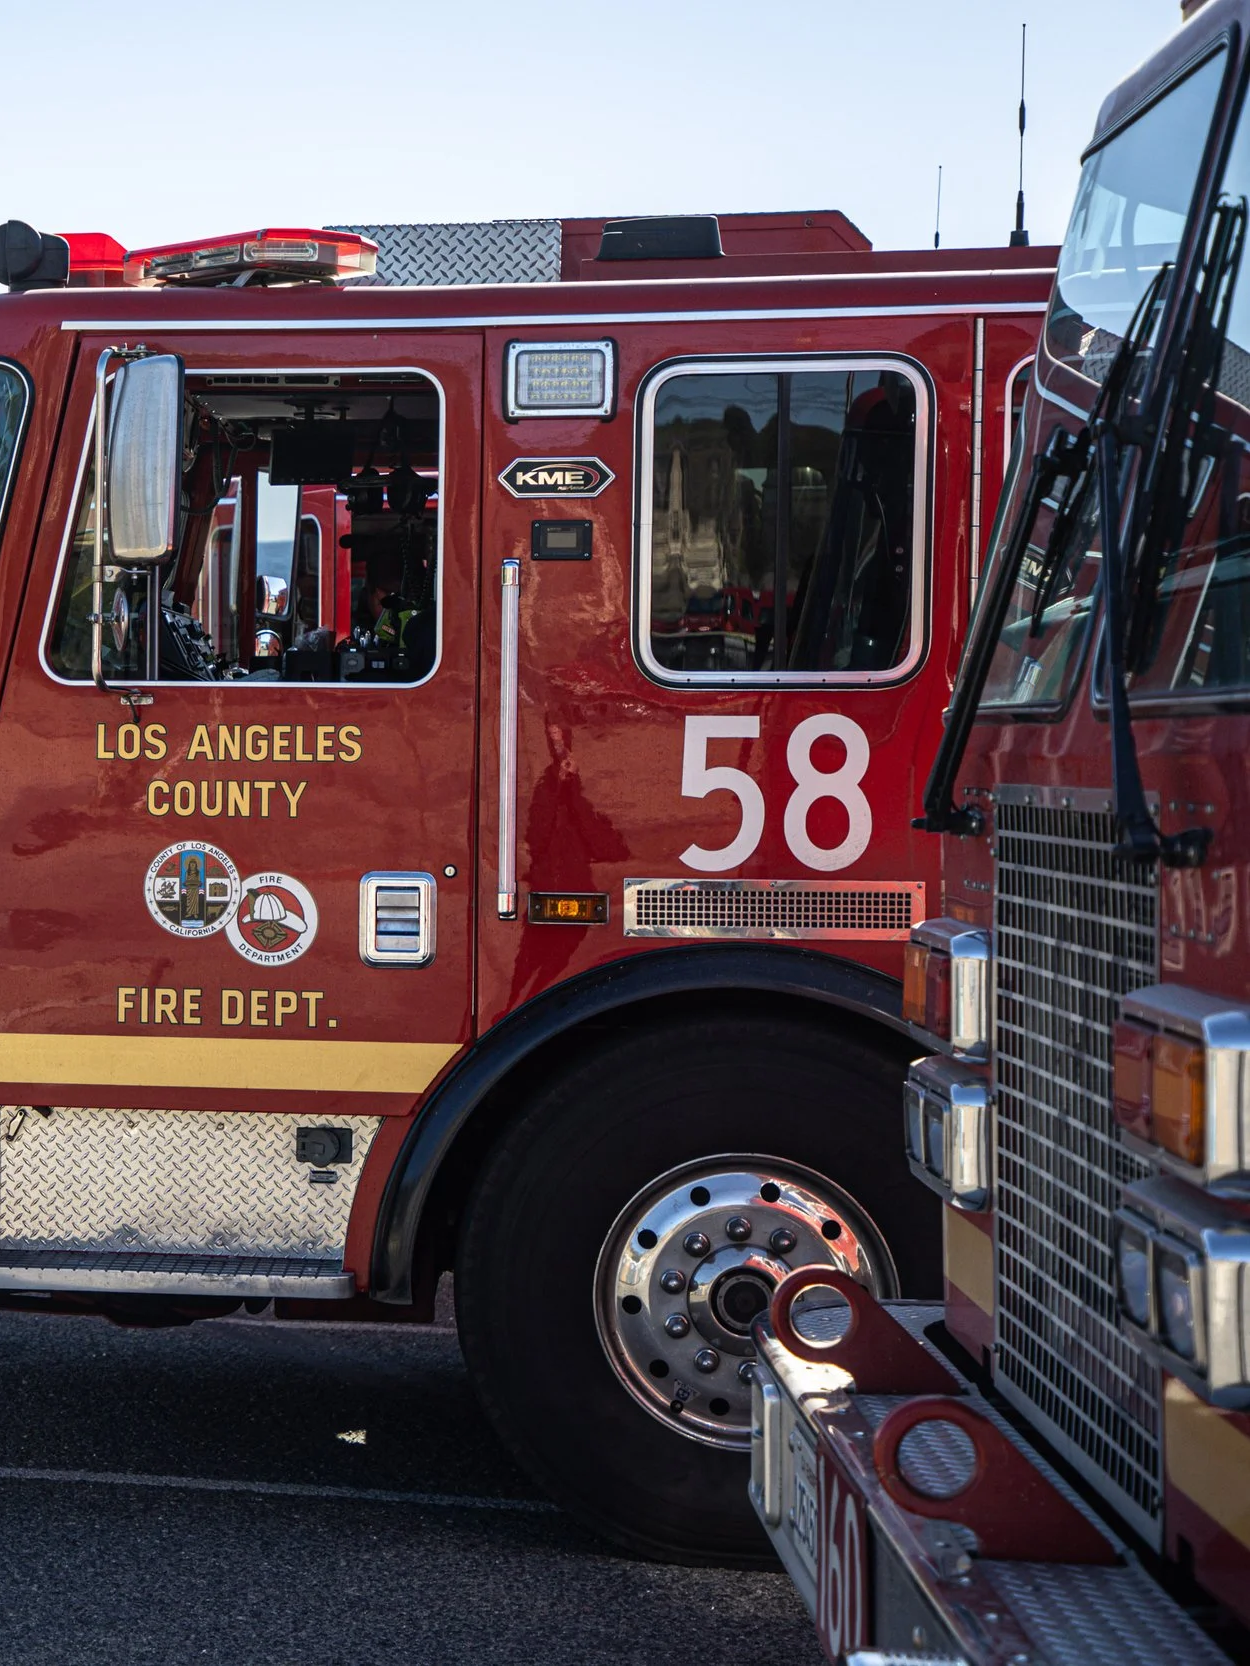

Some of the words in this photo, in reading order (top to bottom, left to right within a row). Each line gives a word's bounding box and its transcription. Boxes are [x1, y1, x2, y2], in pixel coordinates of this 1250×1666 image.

[516, 471, 584, 486] KME
[96, 723, 168, 760] LOS
[186, 724, 363, 762] ANGELES
[147, 779, 308, 818] COUNTY
[679, 713, 873, 872] 58
[150, 848, 174, 873] COUNTY
[176, 842, 187, 851] OF
[191, 842, 207, 851] LOS
[208, 847, 236, 875] ANGELES
[259, 875, 283, 884] FIRE
[169, 924, 217, 937] CALIFORNIA
[238, 942, 304, 963] DEPARTMENT
[117, 986, 202, 1025] FIRE
[221, 988, 338, 1028] DEPT.
[819, 1454, 862, 1658] 160
